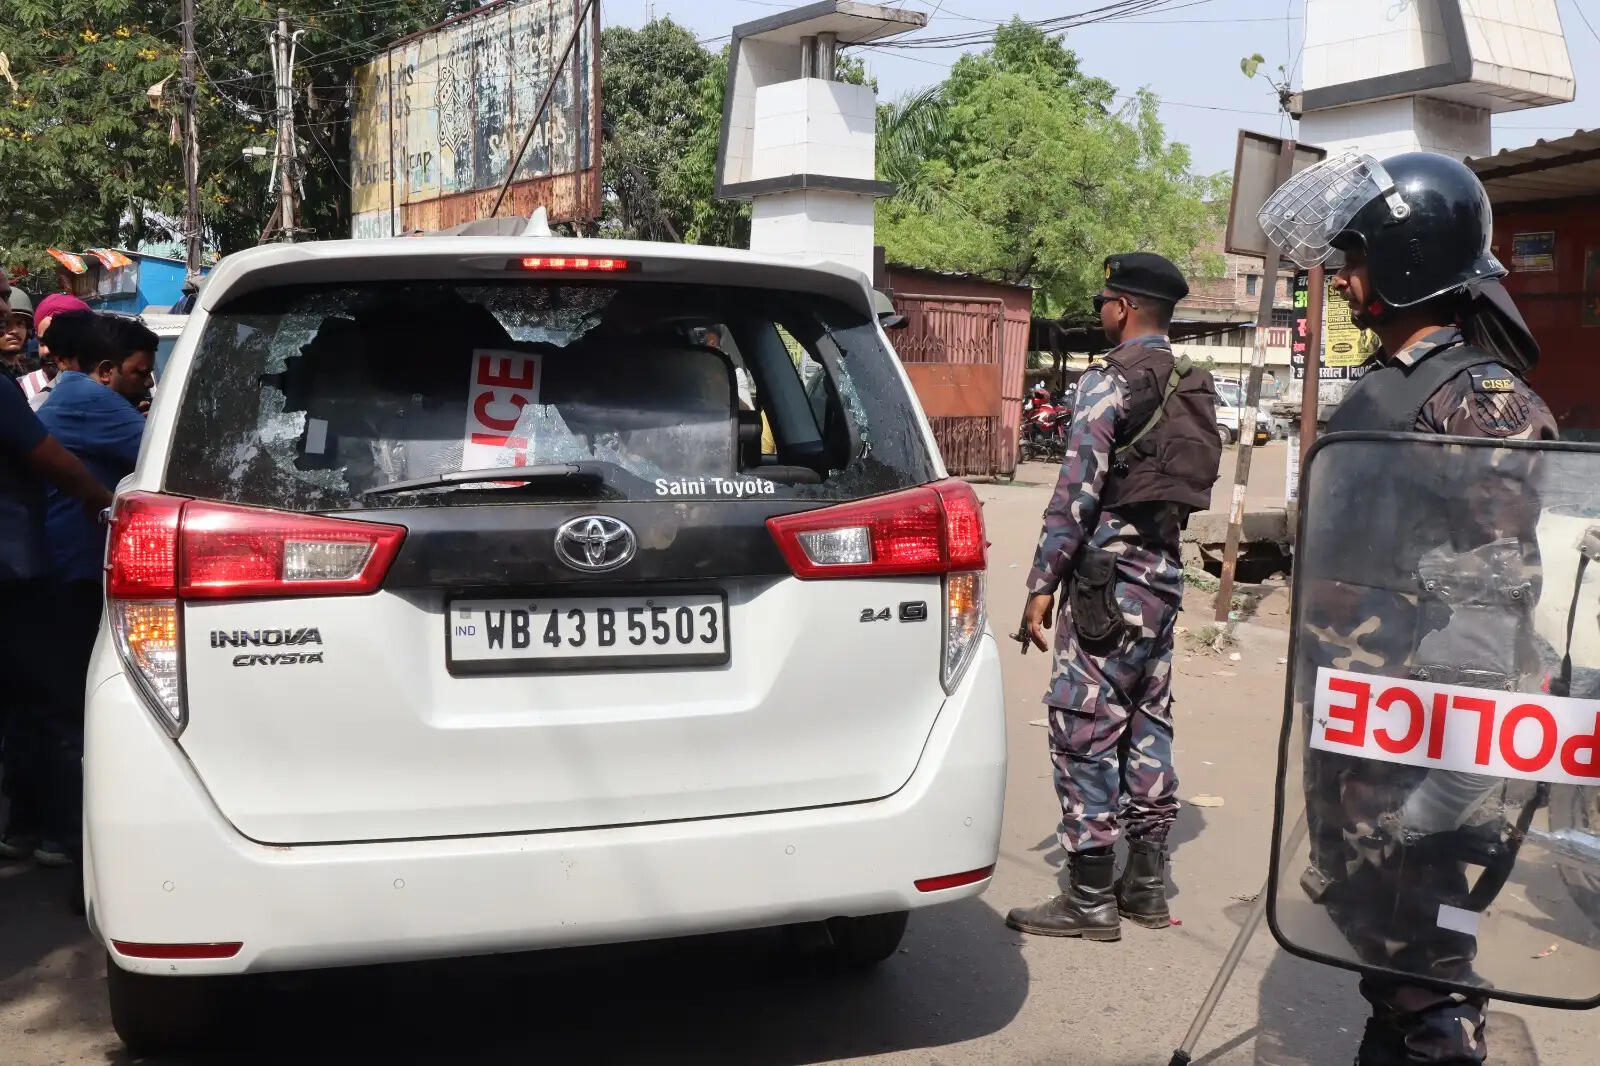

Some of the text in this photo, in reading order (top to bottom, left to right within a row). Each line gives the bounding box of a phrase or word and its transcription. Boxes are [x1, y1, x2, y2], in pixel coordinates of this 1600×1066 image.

[655, 478, 776, 498] Saini Toyota
[210, 627, 323, 648] INNOVA
[455, 625, 476, 637] IND
[484, 605, 718, 650] WB 43 B 5503
[232, 651, 324, 667] CRYSTA
[1325, 677, 1600, 778] POLICE
